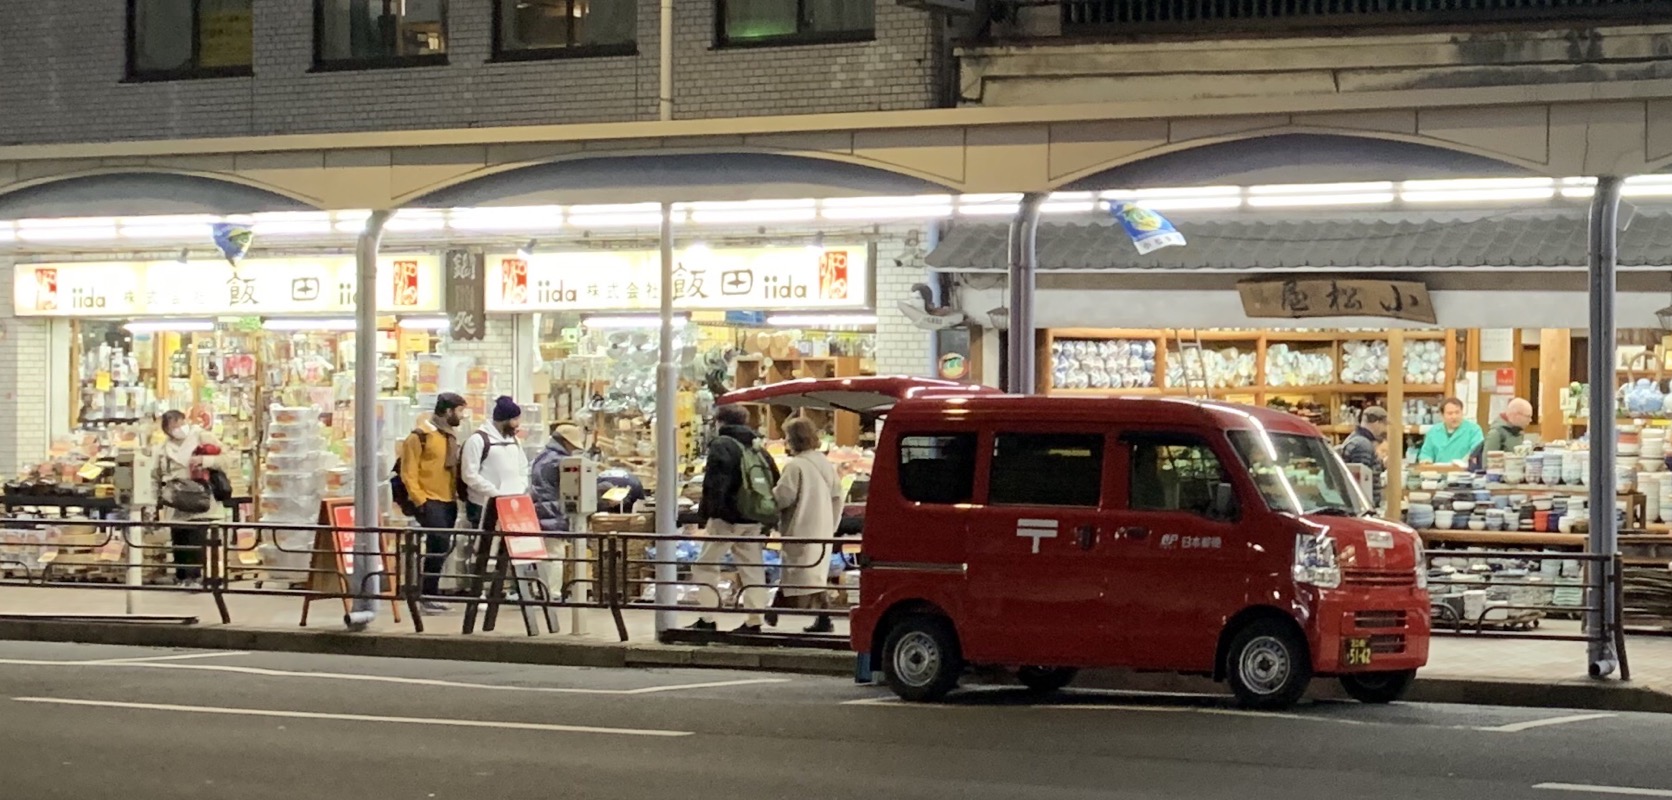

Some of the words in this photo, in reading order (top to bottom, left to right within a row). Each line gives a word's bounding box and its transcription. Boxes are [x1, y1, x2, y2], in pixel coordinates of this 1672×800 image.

[72, 287, 106, 308] iida
[538, 280, 577, 303] iida
[672, 262, 754, 301] 飯田
[764, 275, 807, 299] iida
